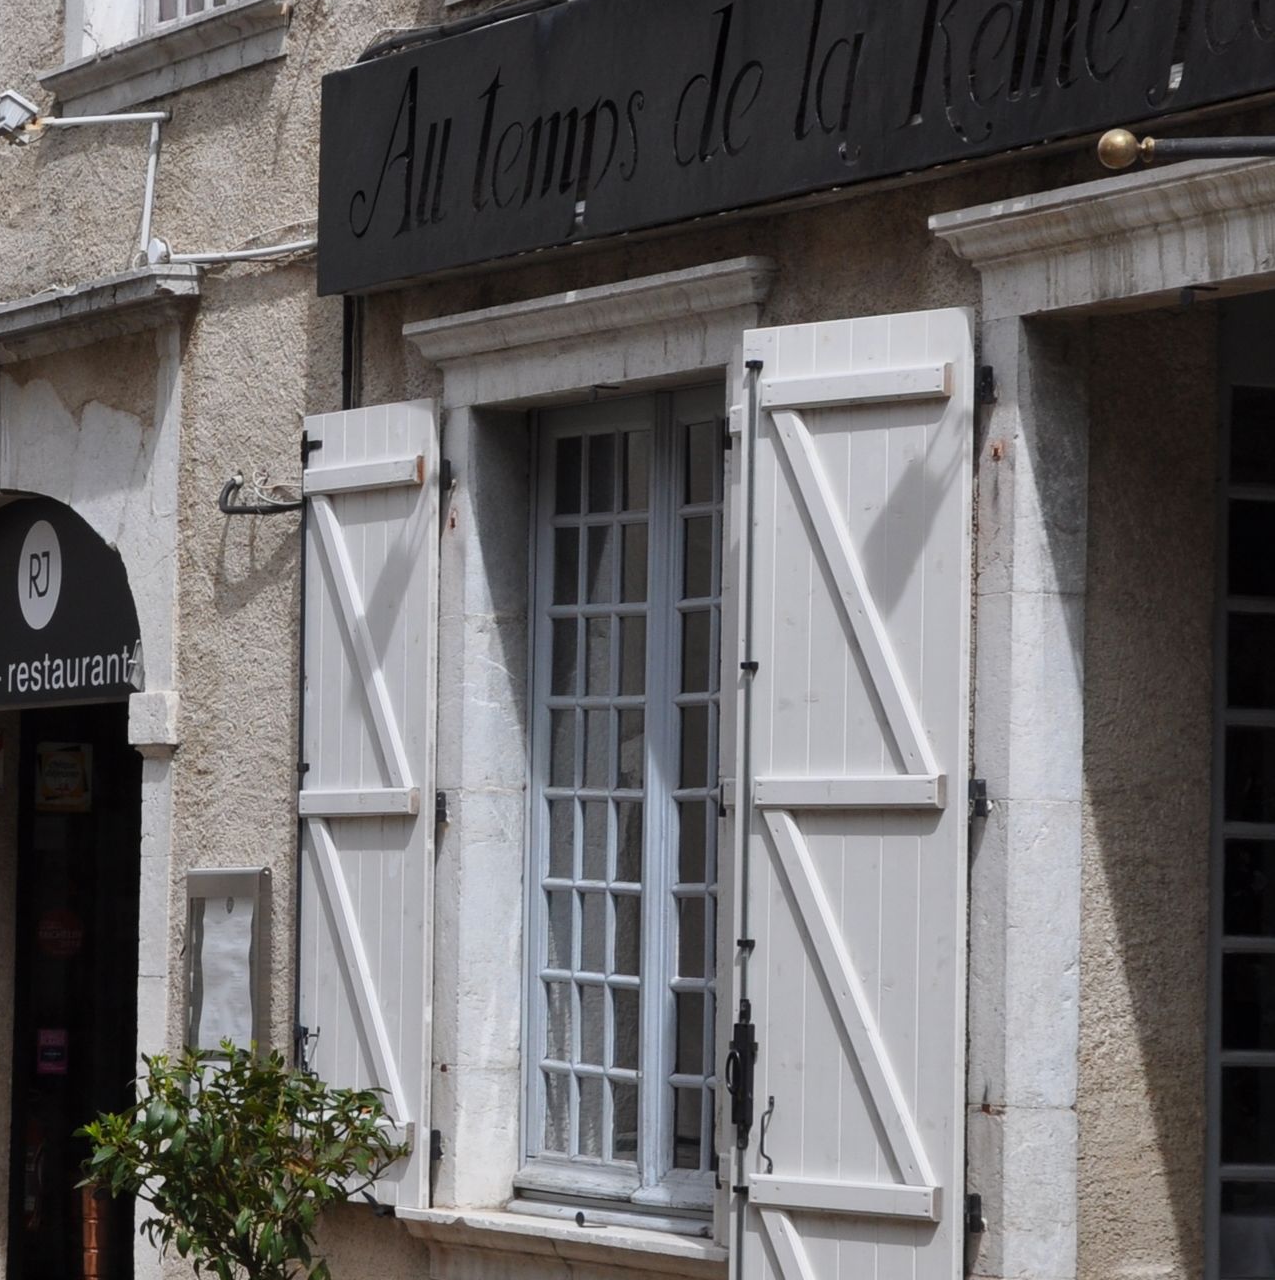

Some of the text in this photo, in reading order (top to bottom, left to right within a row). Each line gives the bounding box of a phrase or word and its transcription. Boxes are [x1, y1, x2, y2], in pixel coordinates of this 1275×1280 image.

[350, 66, 453, 238] Au
[473, 65, 644, 238] temps
[674, 3, 764, 168] de
[28, 551, 51, 600] RJ
[8, 644, 130, 693] restaurant
